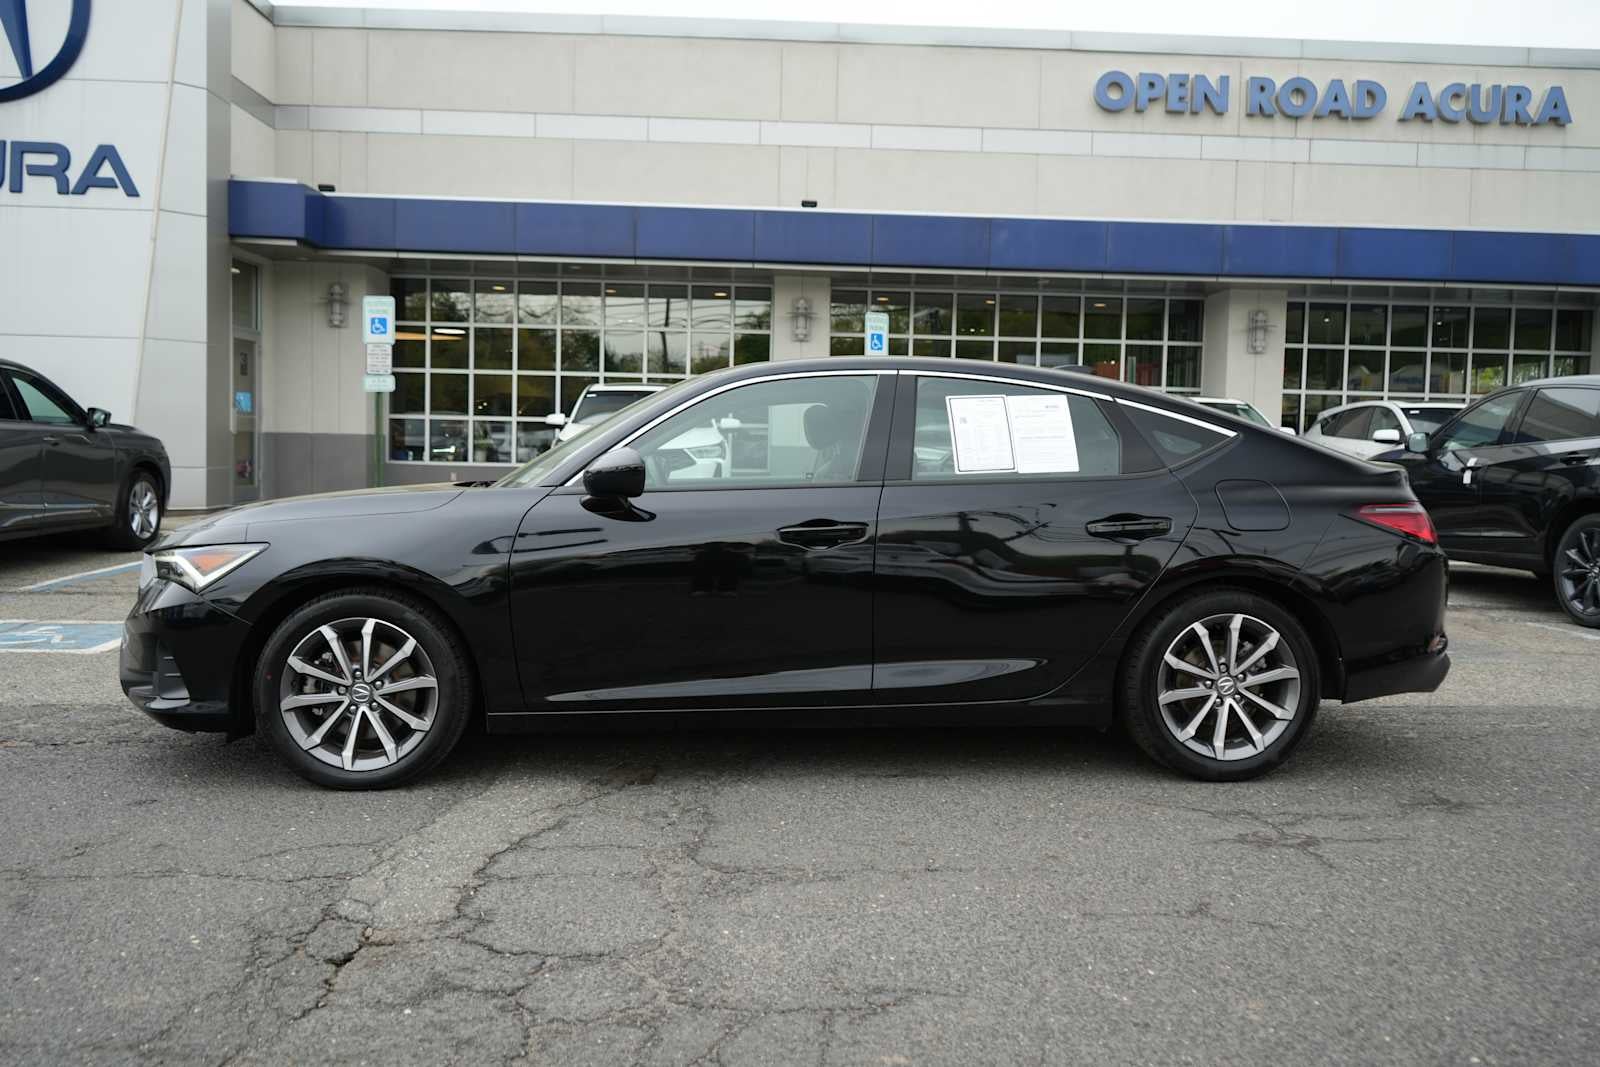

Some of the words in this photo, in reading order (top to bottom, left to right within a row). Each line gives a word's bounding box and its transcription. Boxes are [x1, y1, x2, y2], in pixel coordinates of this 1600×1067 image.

[1094, 70, 1231, 115] OPEN
[1246, 76, 1388, 119] ROAD
[1398, 81, 1573, 127] ACURA
